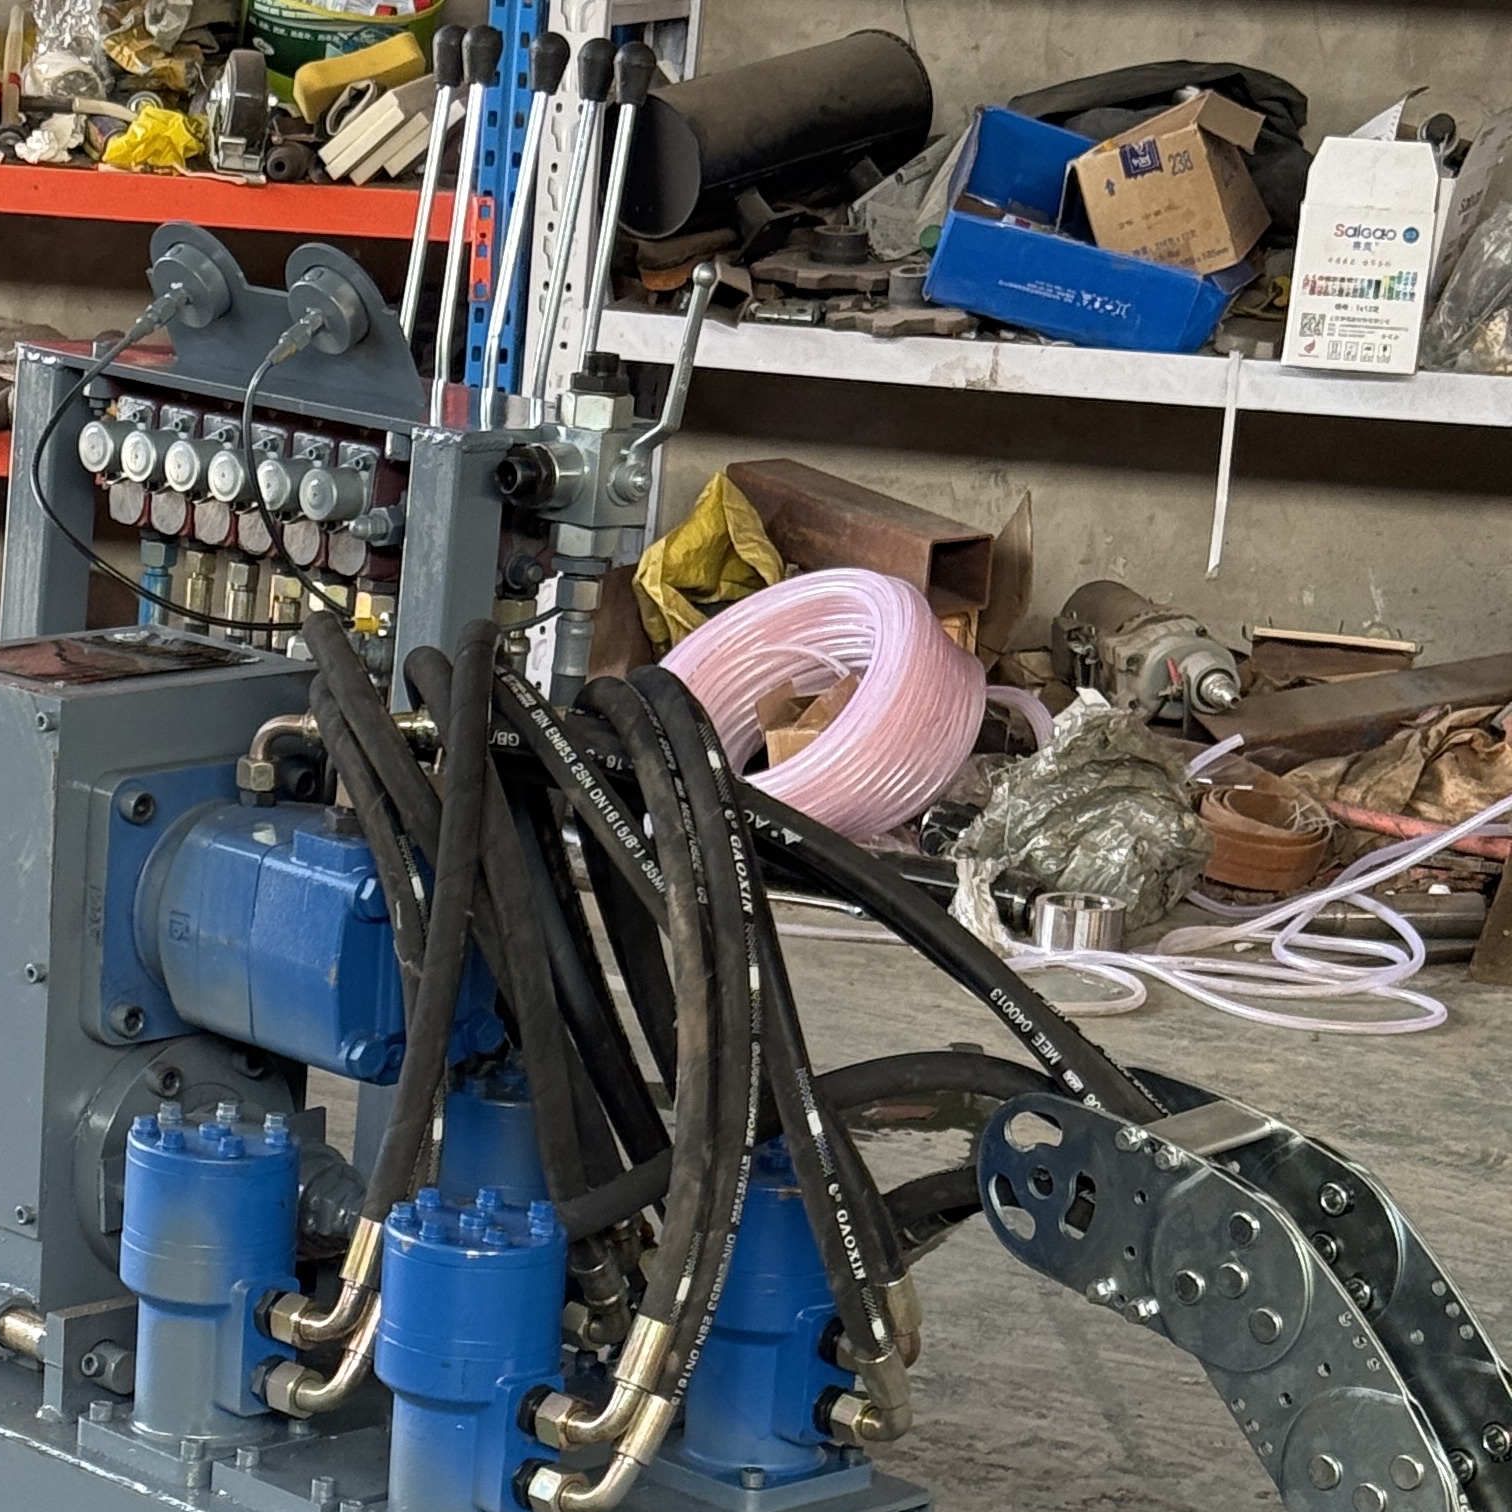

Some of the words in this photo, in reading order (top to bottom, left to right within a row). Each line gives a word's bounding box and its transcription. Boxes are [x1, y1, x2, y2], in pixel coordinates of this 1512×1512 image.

[1168, 150, 1194, 176] 238
[531, 708, 552, 729] DIN
[544, 724, 578, 764] EN853
[571, 762, 597, 790] 2SN
[641, 859, 667, 895] 35M
[729, 834, 754, 916] GAOXIN
[989, 988, 1034, 1033] 040013
[1031, 1031, 1063, 1066] MEE
[836, 1209, 866, 1280] GAOXIN
